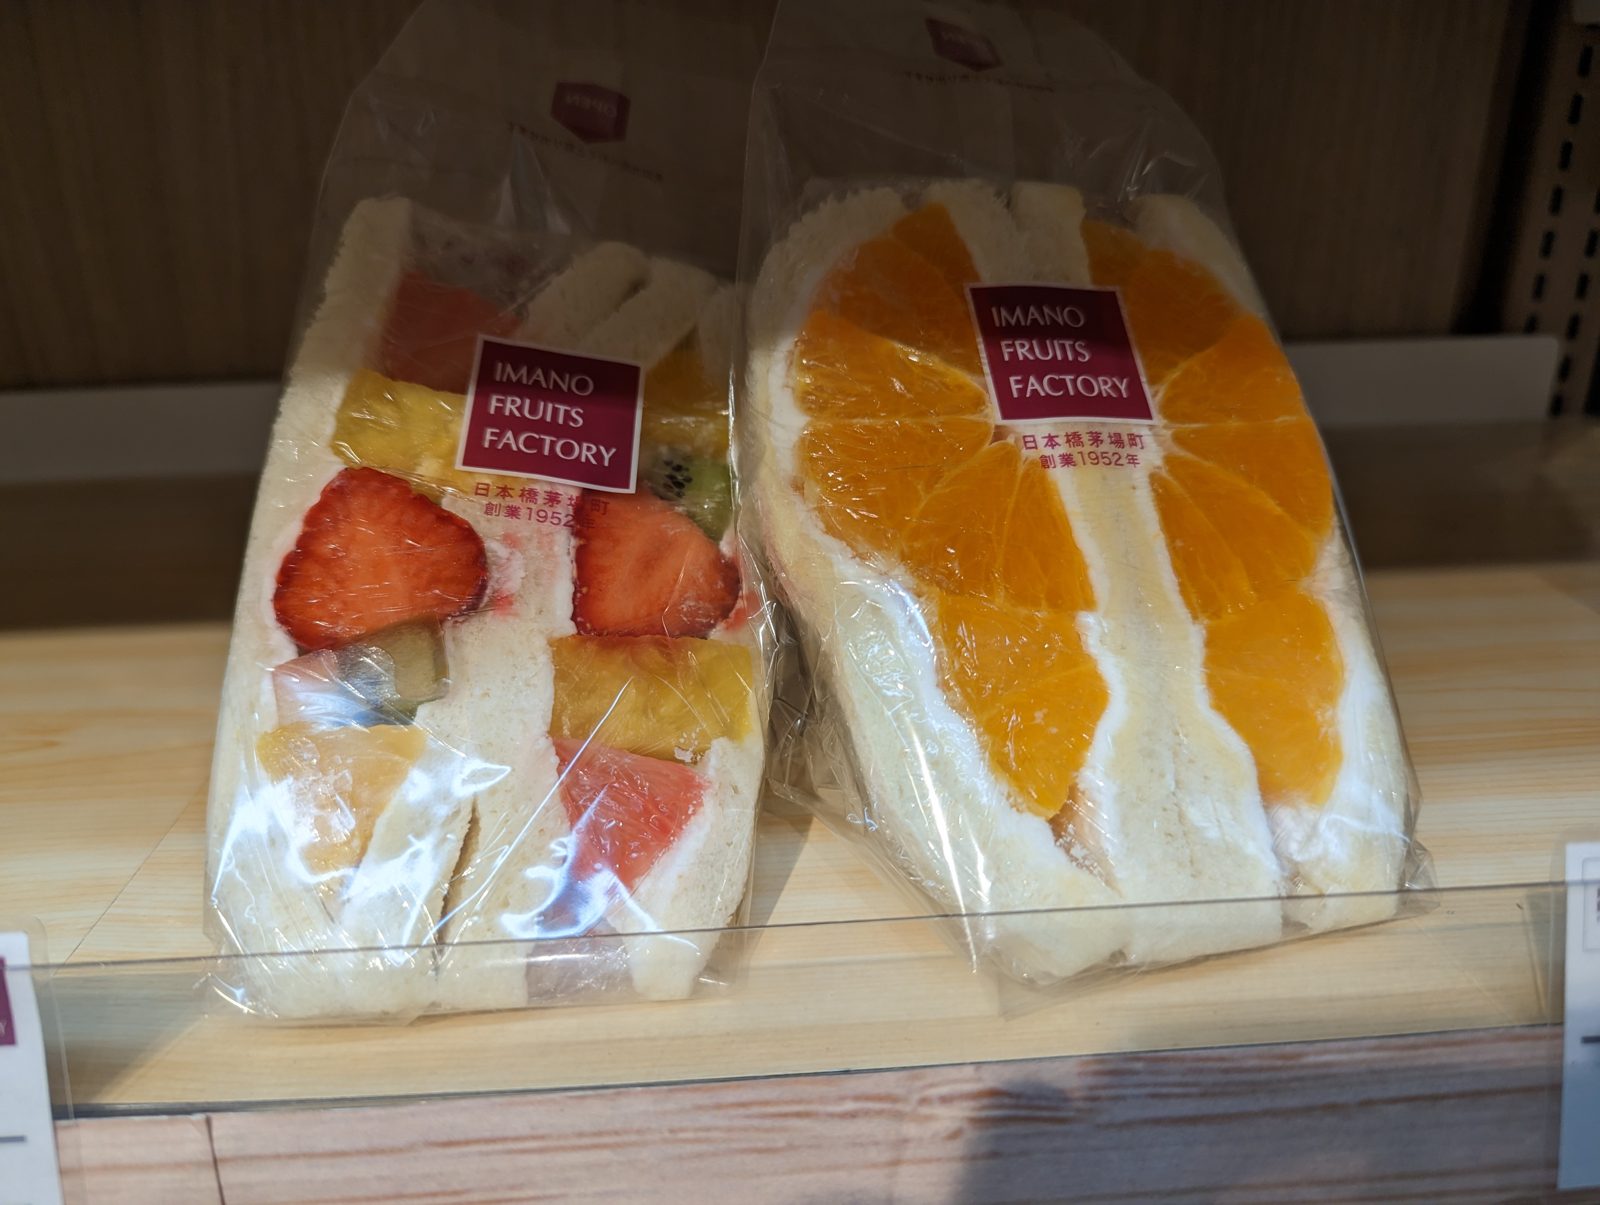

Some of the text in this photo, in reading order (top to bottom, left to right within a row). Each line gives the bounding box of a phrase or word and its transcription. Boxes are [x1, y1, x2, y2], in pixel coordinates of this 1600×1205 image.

[991, 305, 1086, 328] IMANO
[1000, 339, 1091, 363] FRUITS
[494, 362, 595, 397] IMANO
[1009, 374, 1130, 399] FACTORY
[488, 394, 585, 428] FRUITS
[482, 428, 617, 467] FACTORY
[1022, 431, 1145, 451] 日本橋茅場町
[1039, 451, 1141, 469] 創業1952年
